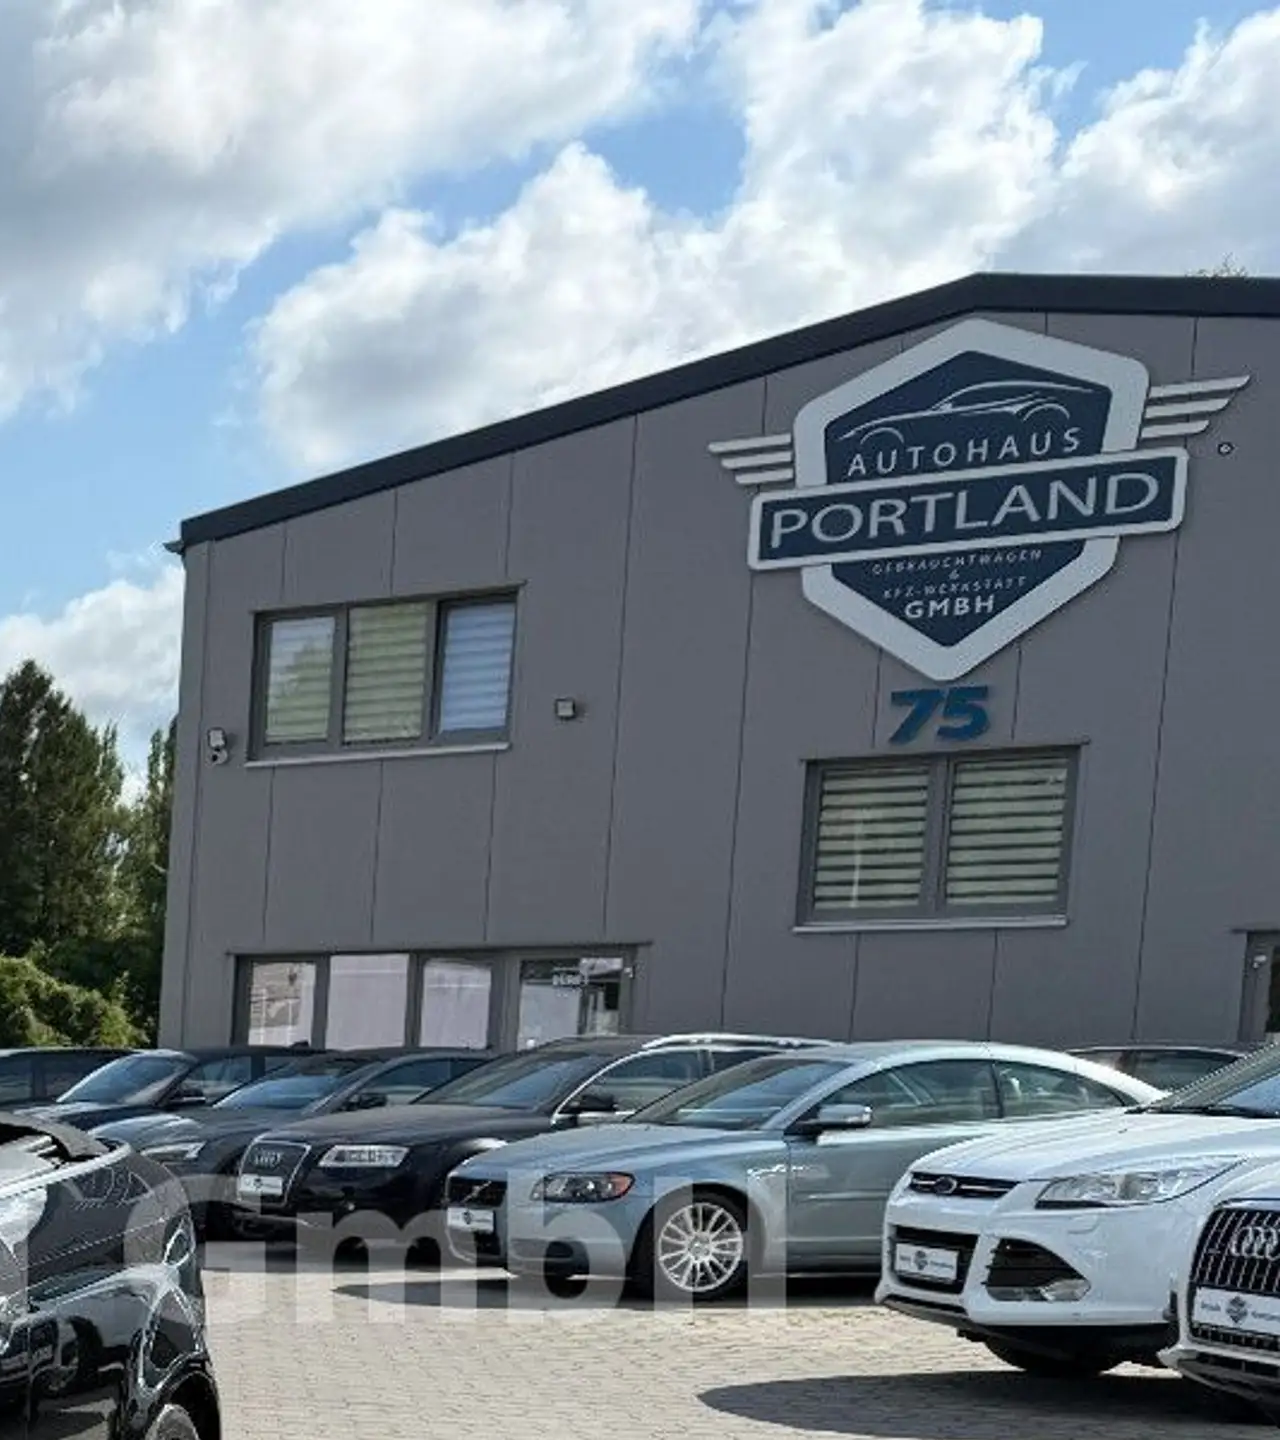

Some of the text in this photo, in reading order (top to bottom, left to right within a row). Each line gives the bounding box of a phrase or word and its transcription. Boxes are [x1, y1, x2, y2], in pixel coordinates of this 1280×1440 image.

[846, 426, 1081, 478] AUTOHAUS
[769, 472, 1160, 549] PORTLAND
[903, 593, 995, 619] GMBH
[888, 685, 991, 745] 75
